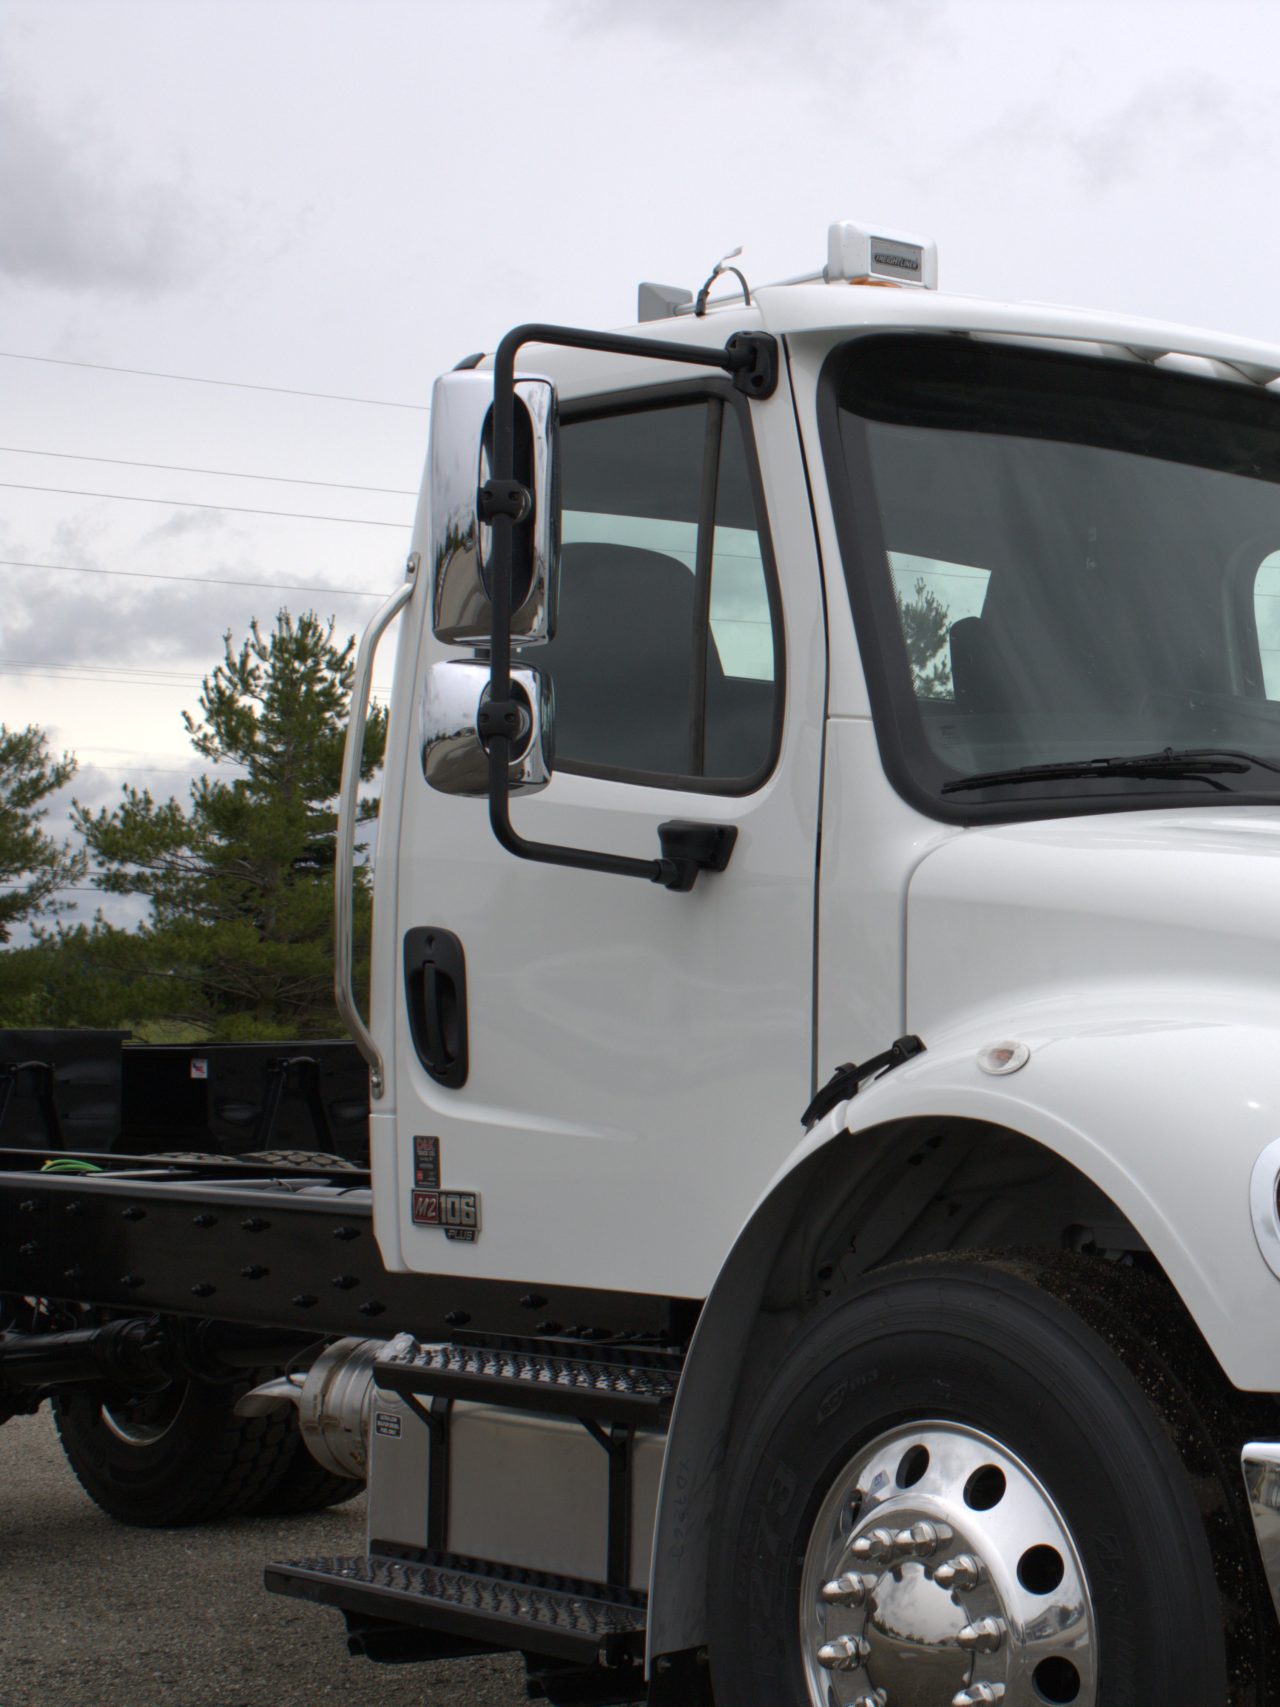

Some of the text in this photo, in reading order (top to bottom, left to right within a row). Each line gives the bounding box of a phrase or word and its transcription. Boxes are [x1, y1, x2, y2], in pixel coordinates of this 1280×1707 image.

[416, 1194, 476, 1225] M2 106
[448, 1229, 473, 1240] PLUS
